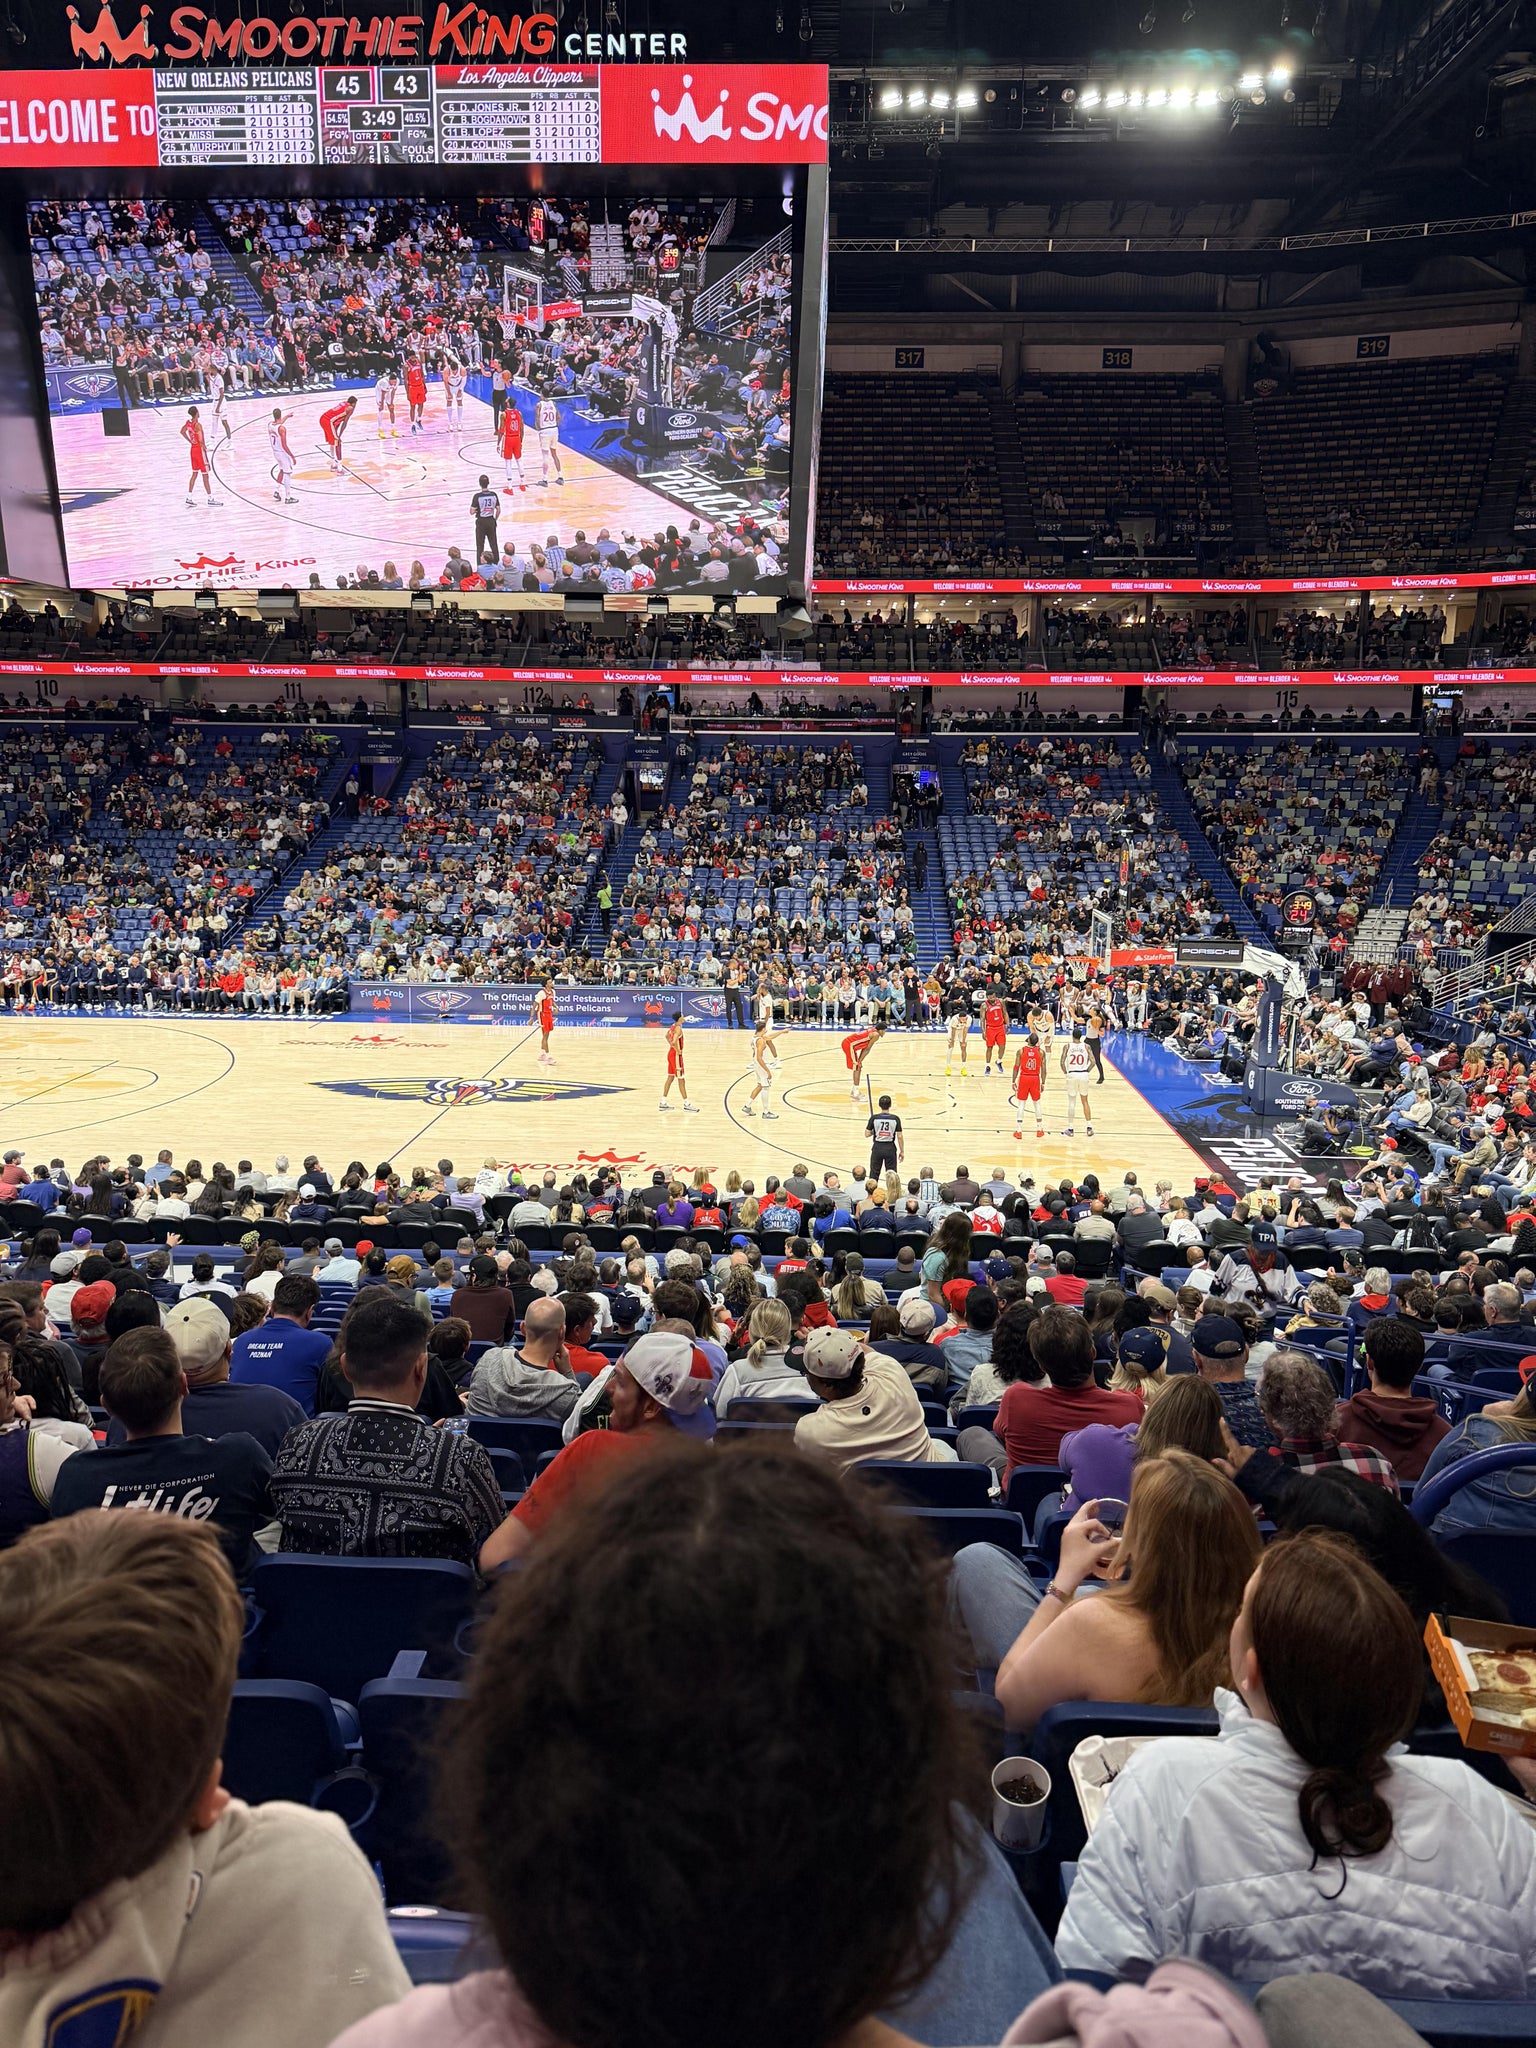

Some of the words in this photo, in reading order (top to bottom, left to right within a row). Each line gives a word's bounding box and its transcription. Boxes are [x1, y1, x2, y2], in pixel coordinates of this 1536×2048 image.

[164, 6, 423, 58] SMOOTHIE
[564, 33, 688, 56] CENTER
[156, 72, 187, 88] NEW
[191, 72, 248, 88] ORLEANS
[252, 71, 313, 87] PELICANS
[457, 67, 480, 84] Los
[481, 66, 531, 88] Angeles
[532, 66, 584, 88] Clippers
[335, 76, 360, 95] 45
[393, 75, 418, 95] 43
[186, 105, 238, 114] WILLIAMSON
[472, 103, 504, 112] JONES
[506, 103, 522, 111] JR.
[125, 105, 155, 137] TO
[187, 118, 220, 126] POOLE
[326, 113, 348, 124] 54.5%
[361, 110, 396, 126] 3:49
[404, 112, 426, 123] 40.5%
[472, 115, 528, 124] BOGDANOVIC
[188, 129, 215, 138] MISSI
[329, 130, 349, 139] FG%
[355, 132, 372, 140] QTR
[381, 132, 391, 140] 24
[407, 130, 428, 139] FG%
[472, 128, 504, 136] LOPEZ
[189, 142, 231, 151] MURPHY
[447, 141, 458, 149] 20
[471, 140, 513, 149] COLLINS
[324, 146, 357, 155] FOULS
[402, 145, 435, 155] FOULS
[191, 155, 211, 163] BEY
[447, 153, 459, 161] 22
[471, 153, 507, 161] MILLER
[586, 298, 630, 306] PORSCHE
[1358, 340, 1387, 355] 319
[897, 351, 921, 366] 317
[1104, 351, 1131, 366] 318
[112, 565, 246, 589] SMOOTHIE
[159, 666, 181, 674] WELCOME
[691, 674, 713, 682] WELCOME
[1050, 675, 1073, 683] WELCOME
[1433, 673, 1459, 681] WELCOME
[1471, 672, 1495, 681] BLENDER
[34, 679, 59, 697] 110
[283, 682, 302, 700] 111
[522, 686, 543, 704] 112
[1016, 691, 1039, 709] 114
[1275, 690, 1299, 708] 115
[1293, 901, 1312, 910] 3:49
[1290, 910, 1307, 921] 24
[360, 989, 382, 998] Fiery
[383, 988, 404, 999] Crab
[482, 993, 499, 1001] The
[501, 993, 533, 1001] Official
[573, 995, 620, 1003] Restaurant
[632, 994, 654, 1004] Fiery
[655, 993, 676, 1004] Crab
[491, 1003, 500, 1011] of
[502, 1003, 521, 1011] the
[575, 1004, 612, 1012] Pelicans
[1069, 1054, 1085, 1066] 20
[1288, 1081, 1315, 1095] Ford
[880, 1121, 890, 1131] 73
[1258, 1232, 1275, 1243] TPA
[247, 1342, 267, 1350] DREAM
[266, 1342, 284, 1350] TEAM
[119, 1484, 142, 1492] NEVER
[159, 1472, 215, 1489] CORPORATION
